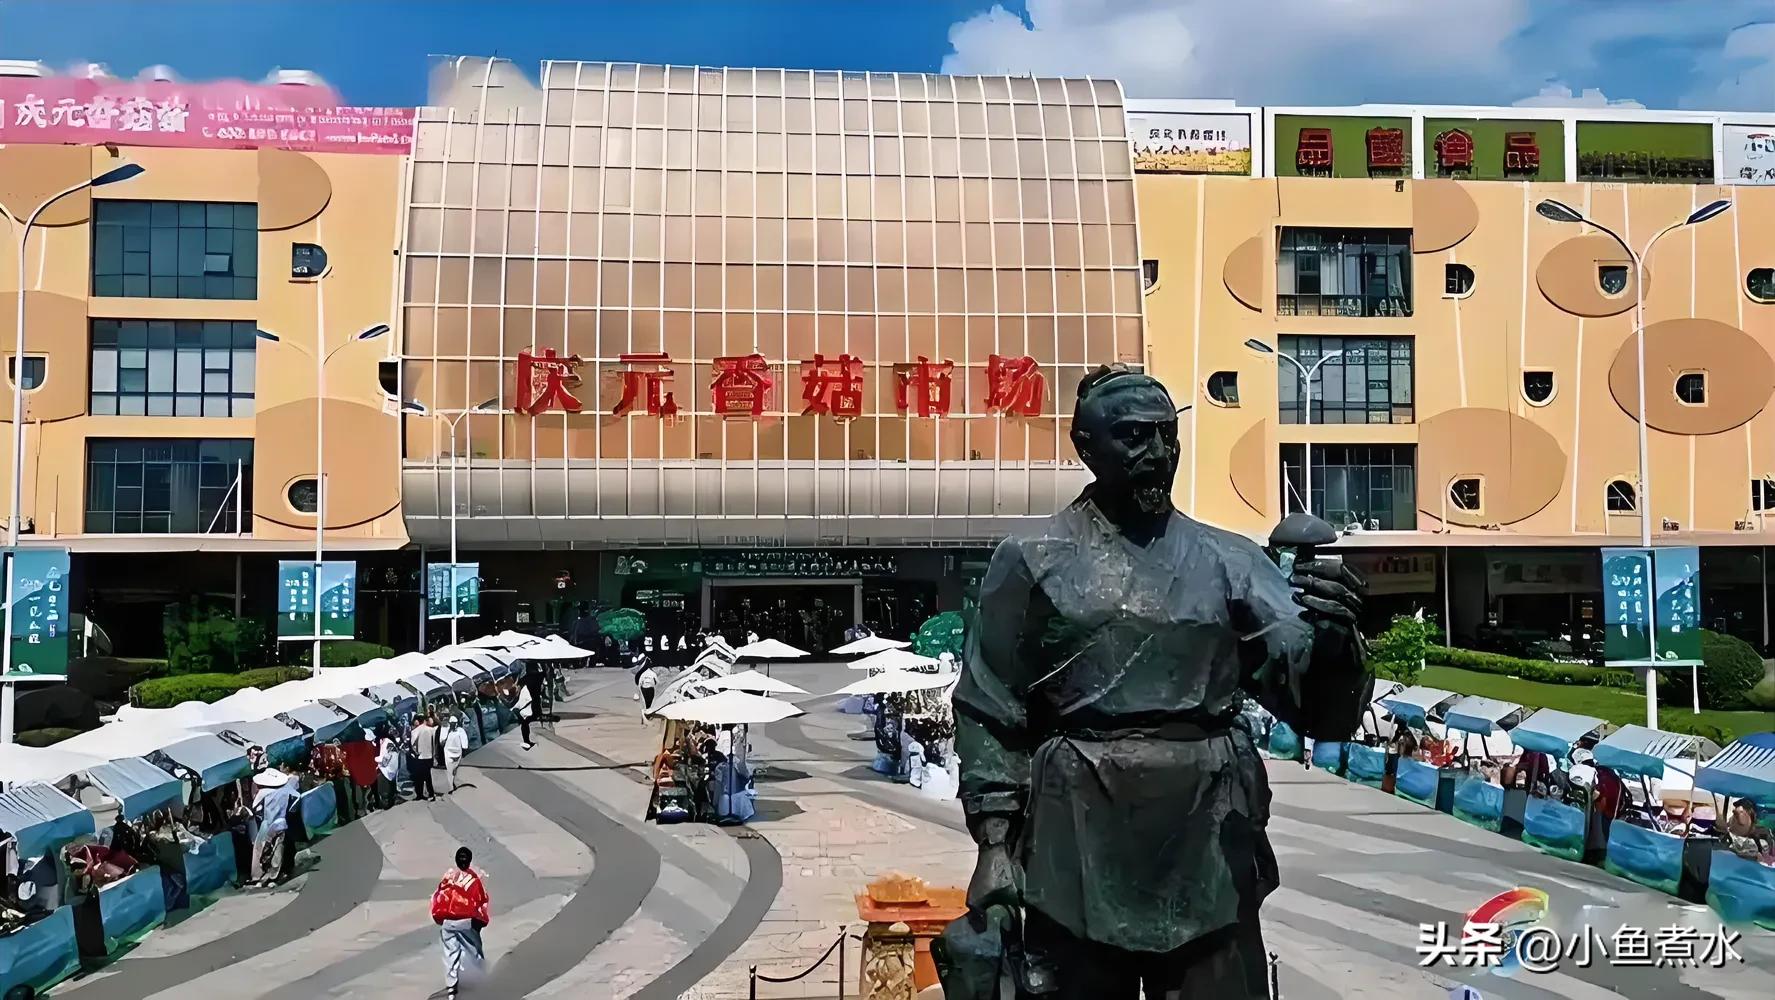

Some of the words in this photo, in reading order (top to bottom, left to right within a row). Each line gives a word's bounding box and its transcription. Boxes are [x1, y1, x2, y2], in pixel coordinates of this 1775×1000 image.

[516, 348, 1045, 418] 庆元香菇市场
